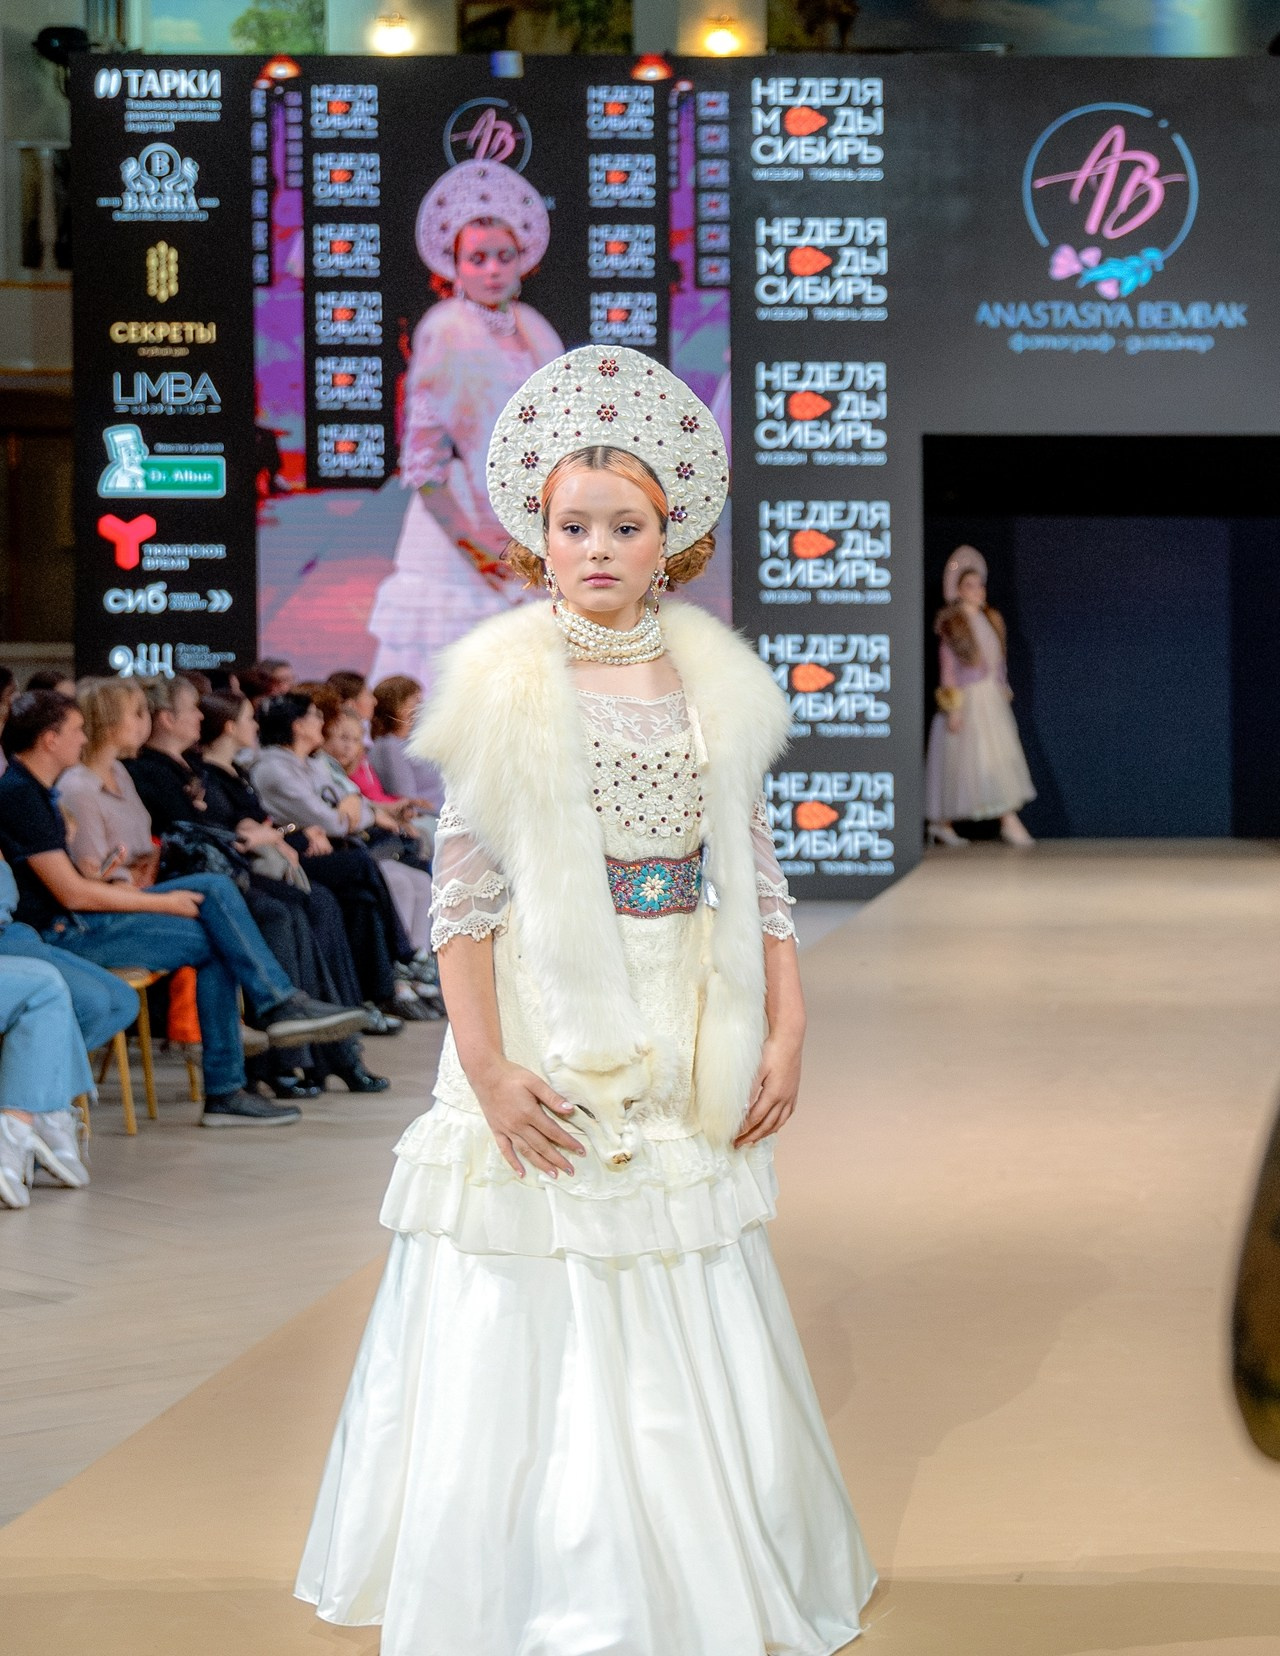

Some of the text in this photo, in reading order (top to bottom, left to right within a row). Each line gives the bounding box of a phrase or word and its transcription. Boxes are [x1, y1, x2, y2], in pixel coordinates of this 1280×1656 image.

[122, 68, 222, 98] ТАРКИ
[751, 77, 883, 107] НЕДЕЛЯ
[751, 135, 884, 165] СИБИРЬ
[755, 217, 888, 248] НЕДЕЛЯ
[755, 275, 888, 305] СИБИРЬ
[975, 301, 1135, 329] ANASTASIYA
[110, 322, 217, 344] СЕКРЕТЫ
[113, 371, 222, 405] LIMBA
[755, 361, 887, 391] НЕДЕЛЯ
[754, 419, 887, 449] СИБИРЬ
[759, 501, 891, 531] НЕДЕЛЯ
[758, 558, 892, 588] СИБИРЬ
[758, 634, 890, 664] НЕДЕЛЯ
[786, 692, 891, 721] ИБИРЬ
[764, 771, 895, 803] НЕДЕЛЯ
